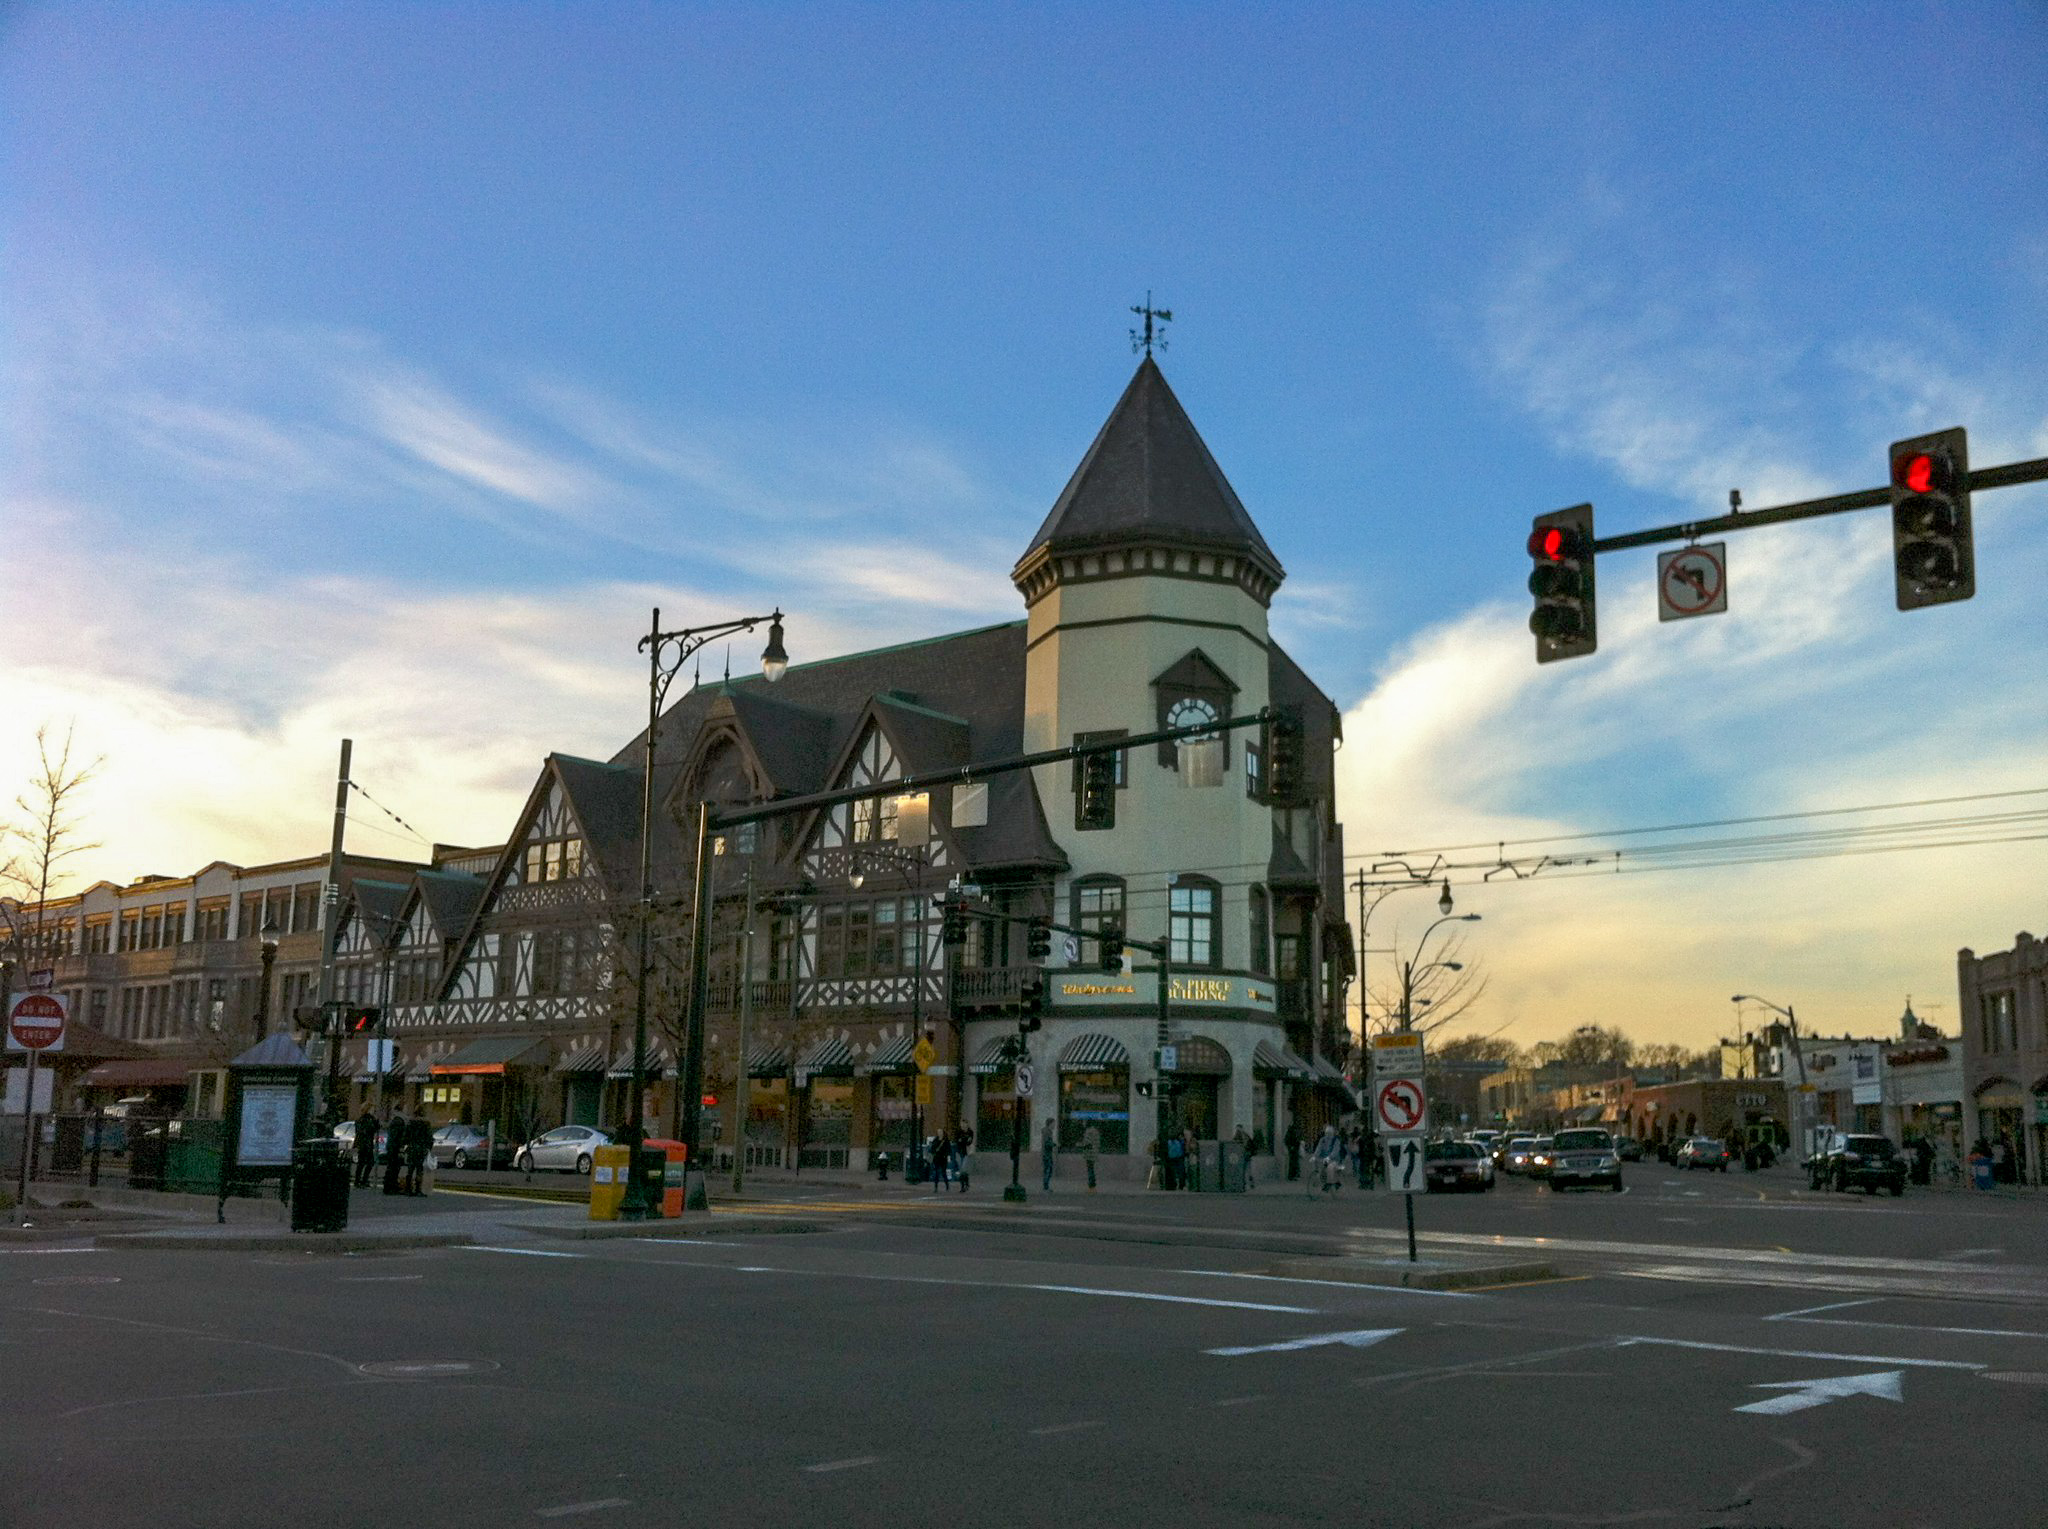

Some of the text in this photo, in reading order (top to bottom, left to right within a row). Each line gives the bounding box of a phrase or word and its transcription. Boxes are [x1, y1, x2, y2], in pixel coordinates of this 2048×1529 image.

[1187, 979, 1232, 992] PIERCE
[22, 1004, 56, 1015] DO NOT
[22, 1030, 51, 1040] ENTER
